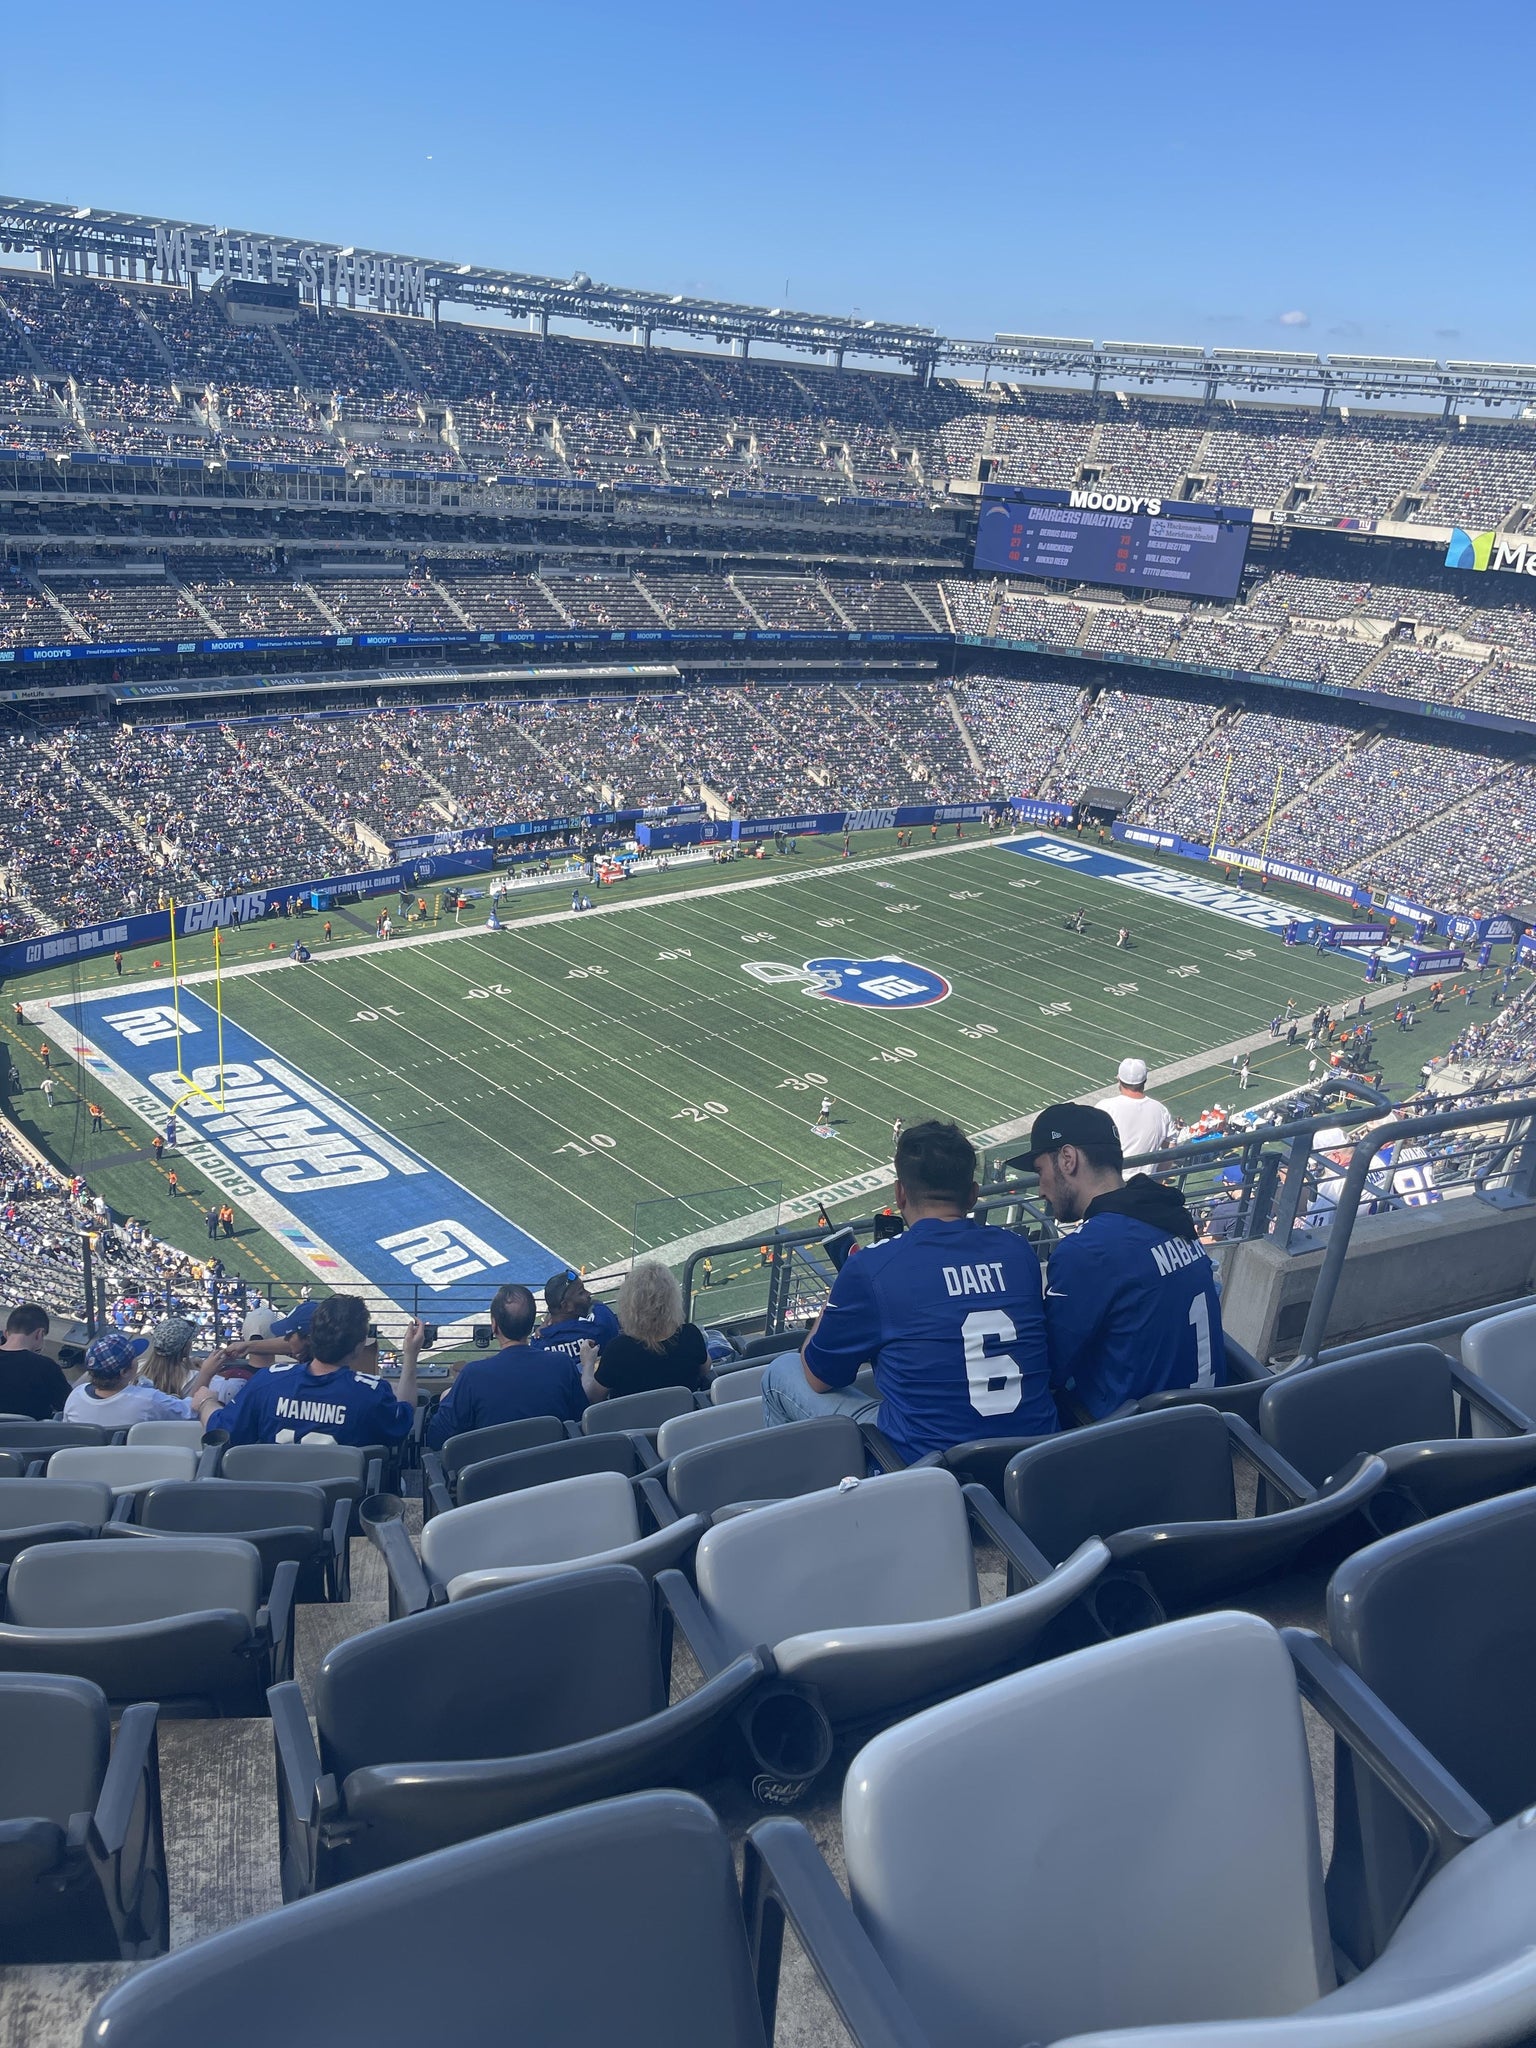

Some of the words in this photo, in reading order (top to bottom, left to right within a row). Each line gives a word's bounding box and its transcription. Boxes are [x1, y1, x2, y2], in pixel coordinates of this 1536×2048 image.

[154, 227, 289, 284] METLIFE
[299, 248, 426, 302] STADIUM
[1069, 491, 1162, 516] MOODY'S
[1013, 524, 1023, 534] 12
[1028, 507, 1081, 525] CHARGERS
[1080, 512, 1135, 530] INACTIVES
[1010, 538, 1022, 547] 27
[34, 650, 71, 659] MOODY'S
[177, 643, 195, 653] GIANTS
[211, 642, 243, 650] MOODY'S
[139, 686, 180, 694] MetLife
[1432, 707, 1466, 720] MetLife
[843, 810, 898, 830] GIANTS
[1216, 849, 1242, 862] NEW
[1242, 856, 1267, 872] YORK
[1267, 863, 1315, 886] FOOTBALL
[1316, 876, 1354, 897] GIANTS
[338, 878, 374, 895] FOOTBALL
[374, 875, 400, 887] GIANTS
[1116, 870, 1314, 926] GIANTS
[183, 891, 268, 934] GIANTS
[26, 944, 42, 963] GO
[42, 934, 79, 959] BIG
[78, 925, 128, 950] BLUE
[1222, 948, 1254, 960] 10
[1164, 964, 1198, 978] 20
[1102, 982, 1138, 996] 30
[1038, 1000, 1072, 1016] 40
[101, 1005, 203, 1047] ny
[958, 1022, 999, 1040] 50
[879, 1046, 918, 1063] 40
[783, 1072, 829, 1092] 30
[680, 1100, 729, 1122] 20
[148, 1060, 392, 1193] GIANTS
[564, 1133, 617, 1158] 10
[785, 1174, 883, 1214] CANCER
[375, 1219, 509, 1292] ny
[942, 1262, 1006, 1297] DART
[1188, 1291, 1216, 1389] 1
[960, 1309, 1023, 1417] 6
[276, 1396, 347, 1425] MANNING
